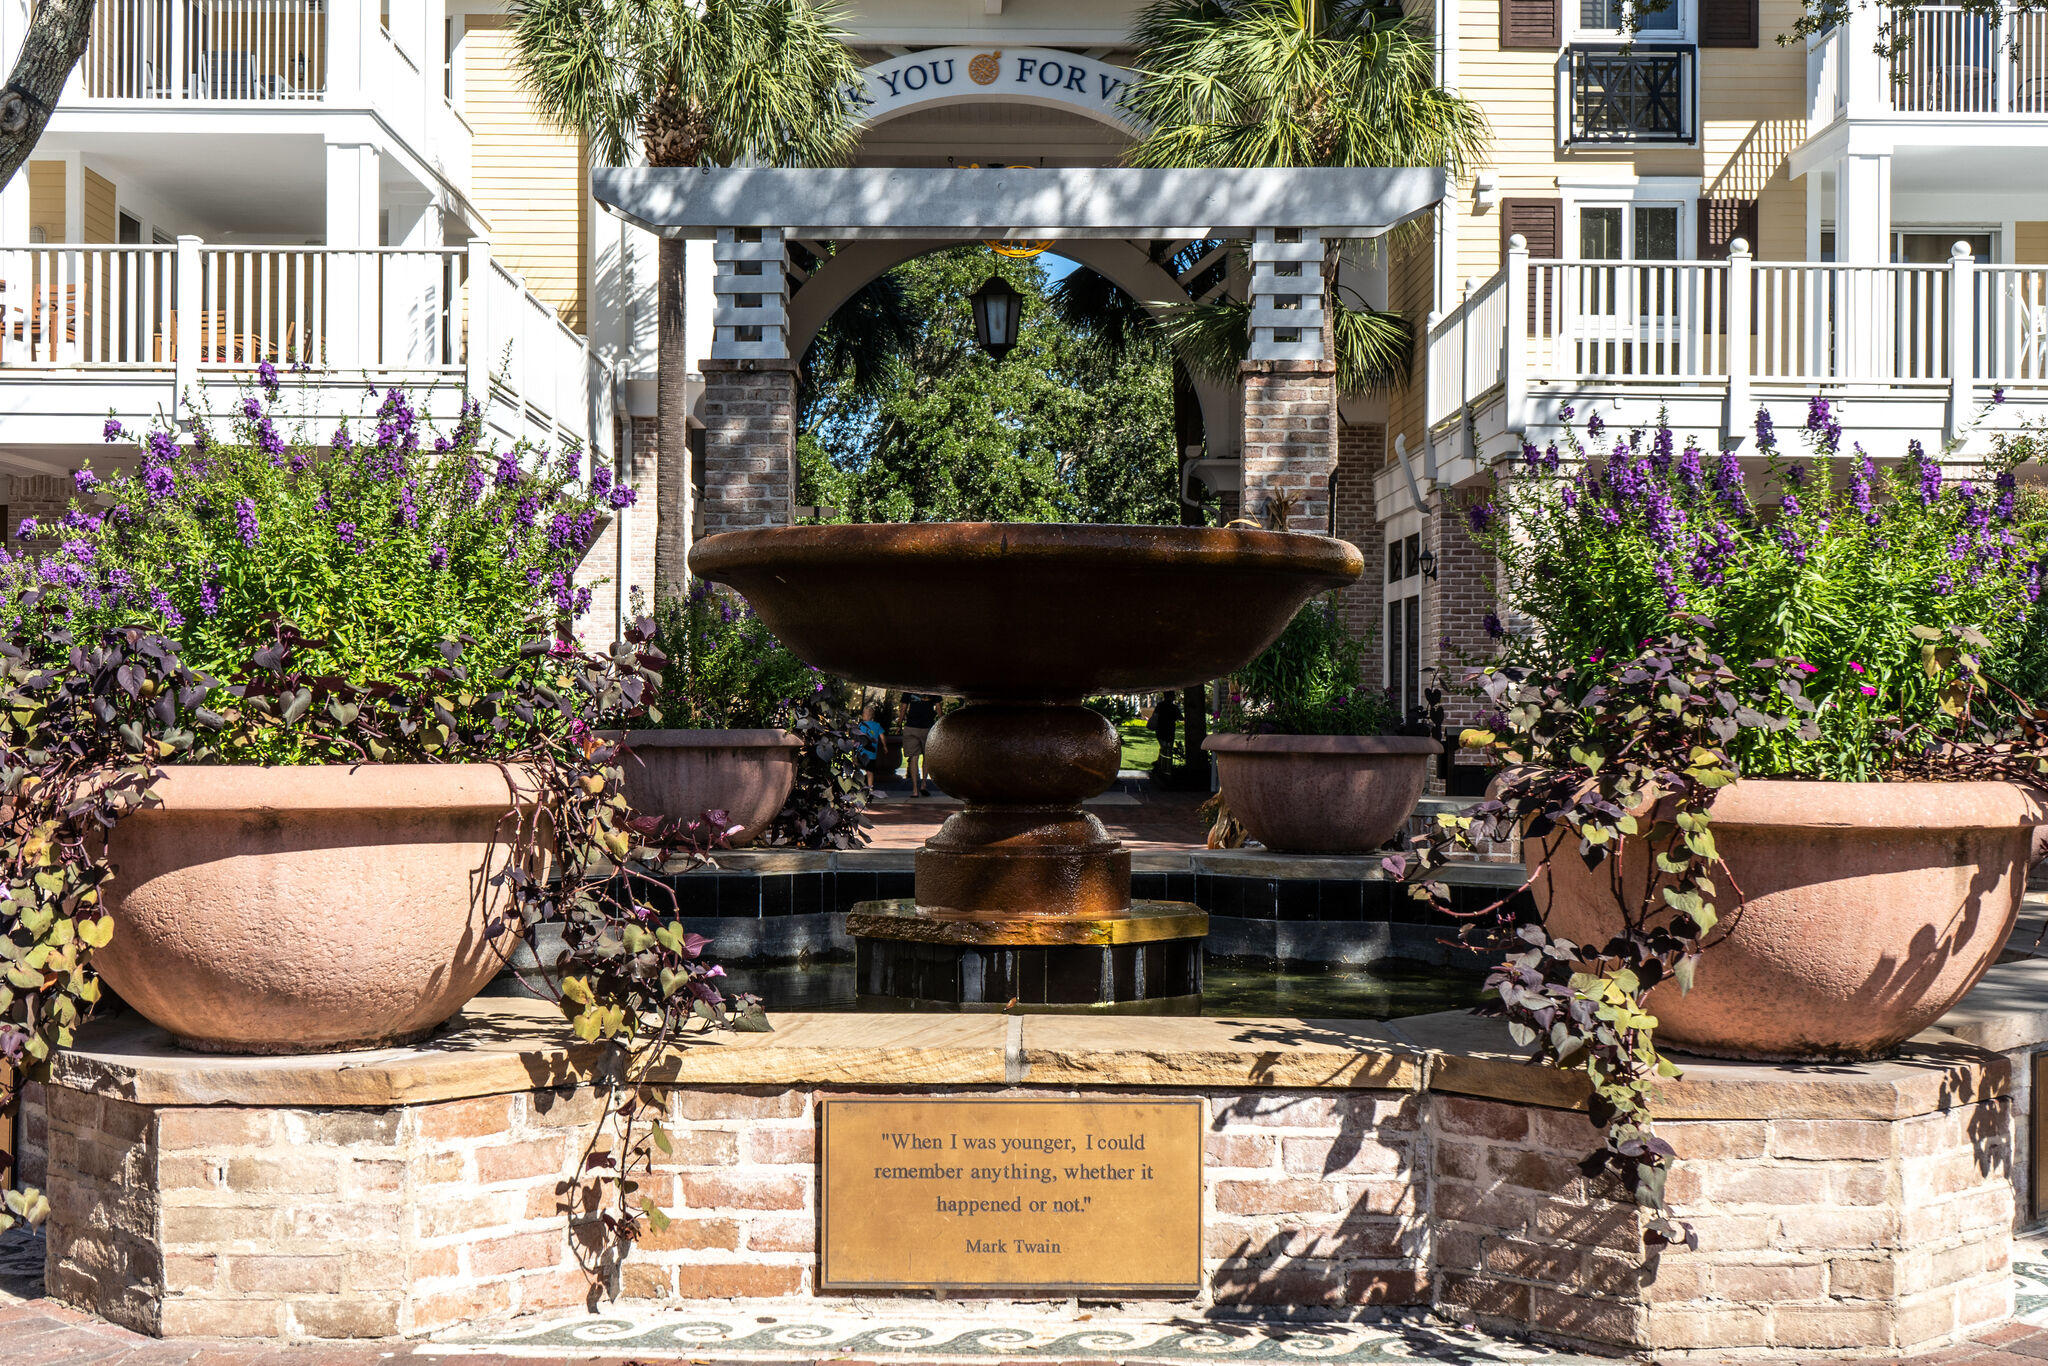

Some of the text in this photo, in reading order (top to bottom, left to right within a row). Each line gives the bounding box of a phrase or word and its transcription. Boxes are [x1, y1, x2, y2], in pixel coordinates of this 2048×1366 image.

[876, 58, 955, 98] YOU
[1015, 57, 1088, 94] FOR
[881, 1132, 1146, 1155] "When I was younger, I could
[874, 1162, 1154, 1184] remember anything, whether it
[936, 1195, 1092, 1217] happened or not."
[966, 1238, 1062, 1254] Mark Twain
